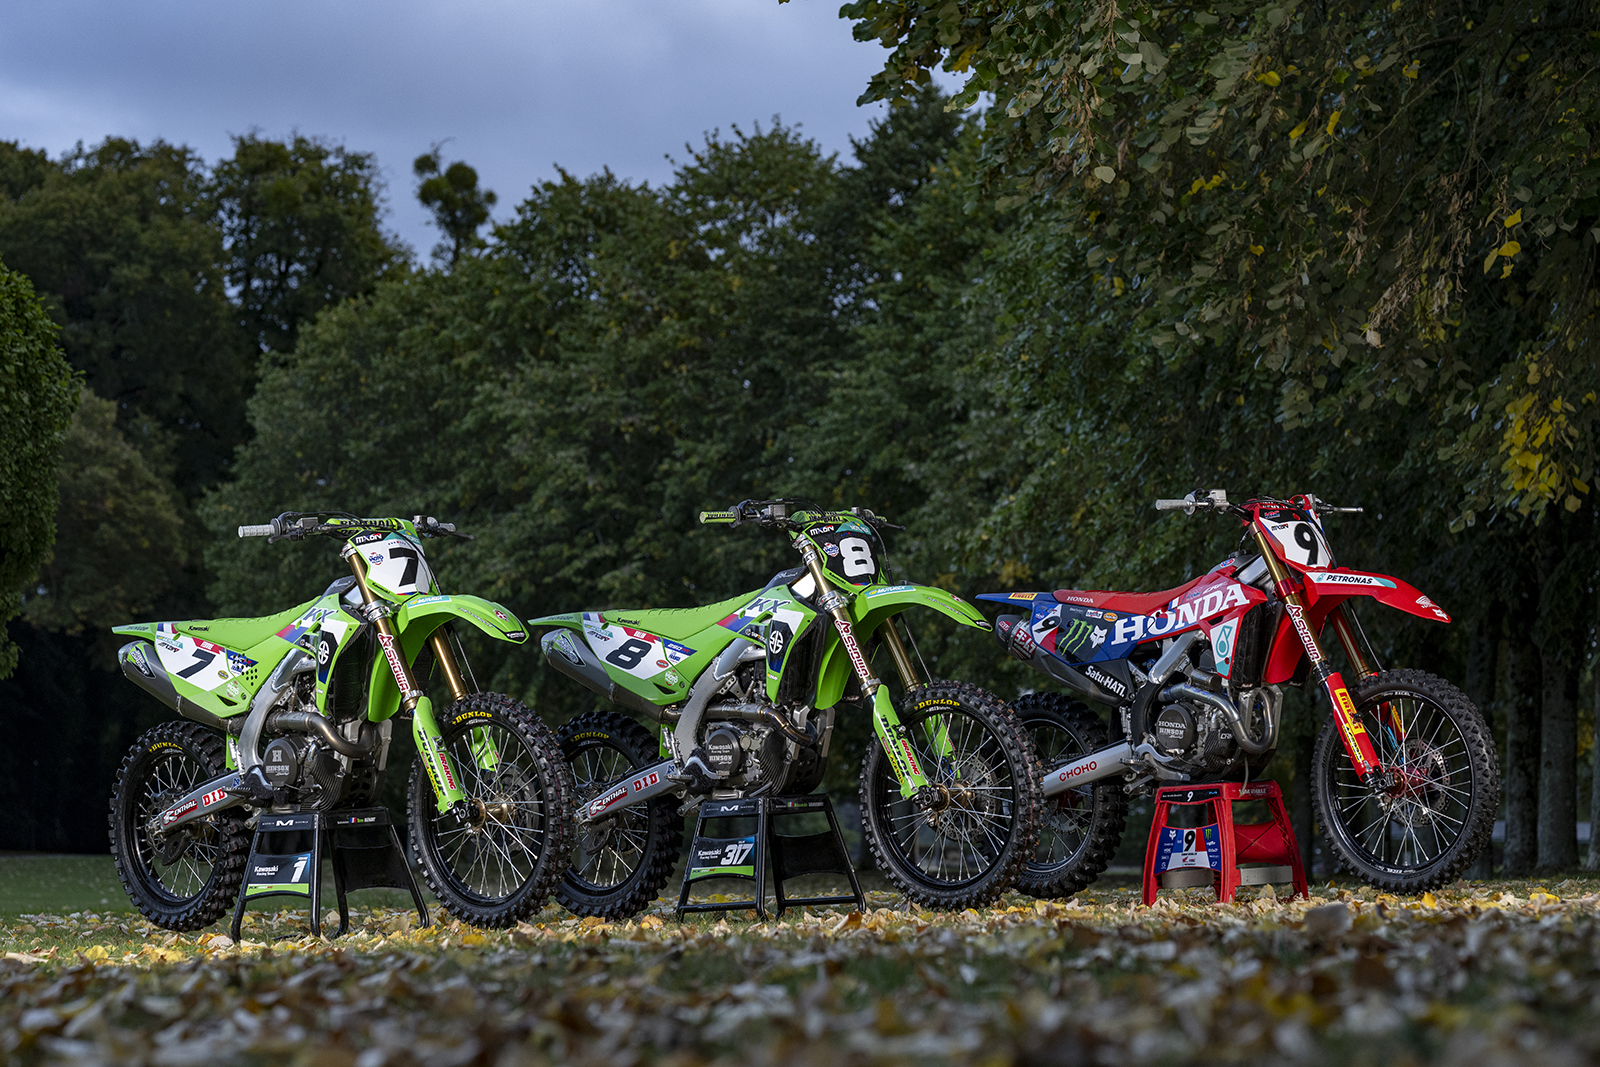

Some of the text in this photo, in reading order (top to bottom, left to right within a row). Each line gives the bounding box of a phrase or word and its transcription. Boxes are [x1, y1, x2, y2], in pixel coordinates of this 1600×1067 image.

[1294, 522, 1318, 567] 9
[388, 547, 418, 587] 7
[839, 537, 875, 577] 8
[1326, 575, 1373, 584] PETRONAS
[302, 607, 337, 623] KX
[747, 597, 789, 613] KX
[1111, 584, 1250, 645] HONDA
[1034, 616, 1061, 633] 9
[1294, 619, 1321, 662] SHOWA
[176, 648, 216, 679] 7
[605, 638, 652, 669] 8
[843, 636, 868, 678] SHOWA
[385, 648, 410, 692] SHOWA
[1085, 665, 1105, 684] Satu
[919, 699, 960, 709] DUNLOP
[456, 711, 493, 722] DUNLOP
[1158, 721, 1186, 729] HONDA
[151, 742, 183, 751] DUNLO
[574, 731, 609, 741] DUNLOP
[901, 739, 920, 775] BRAKING
[439, 753, 457, 790] BRAKING
[1059, 760, 1097, 782] CHOHO
[589, 786, 628, 816] RENTHAL
[1187, 791, 1194, 801] 9
[162, 799, 198, 825] RENTHAL
[1184, 830, 1196, 852] 9
[720, 843, 754, 865] 317
[290, 860, 307, 882] 1
